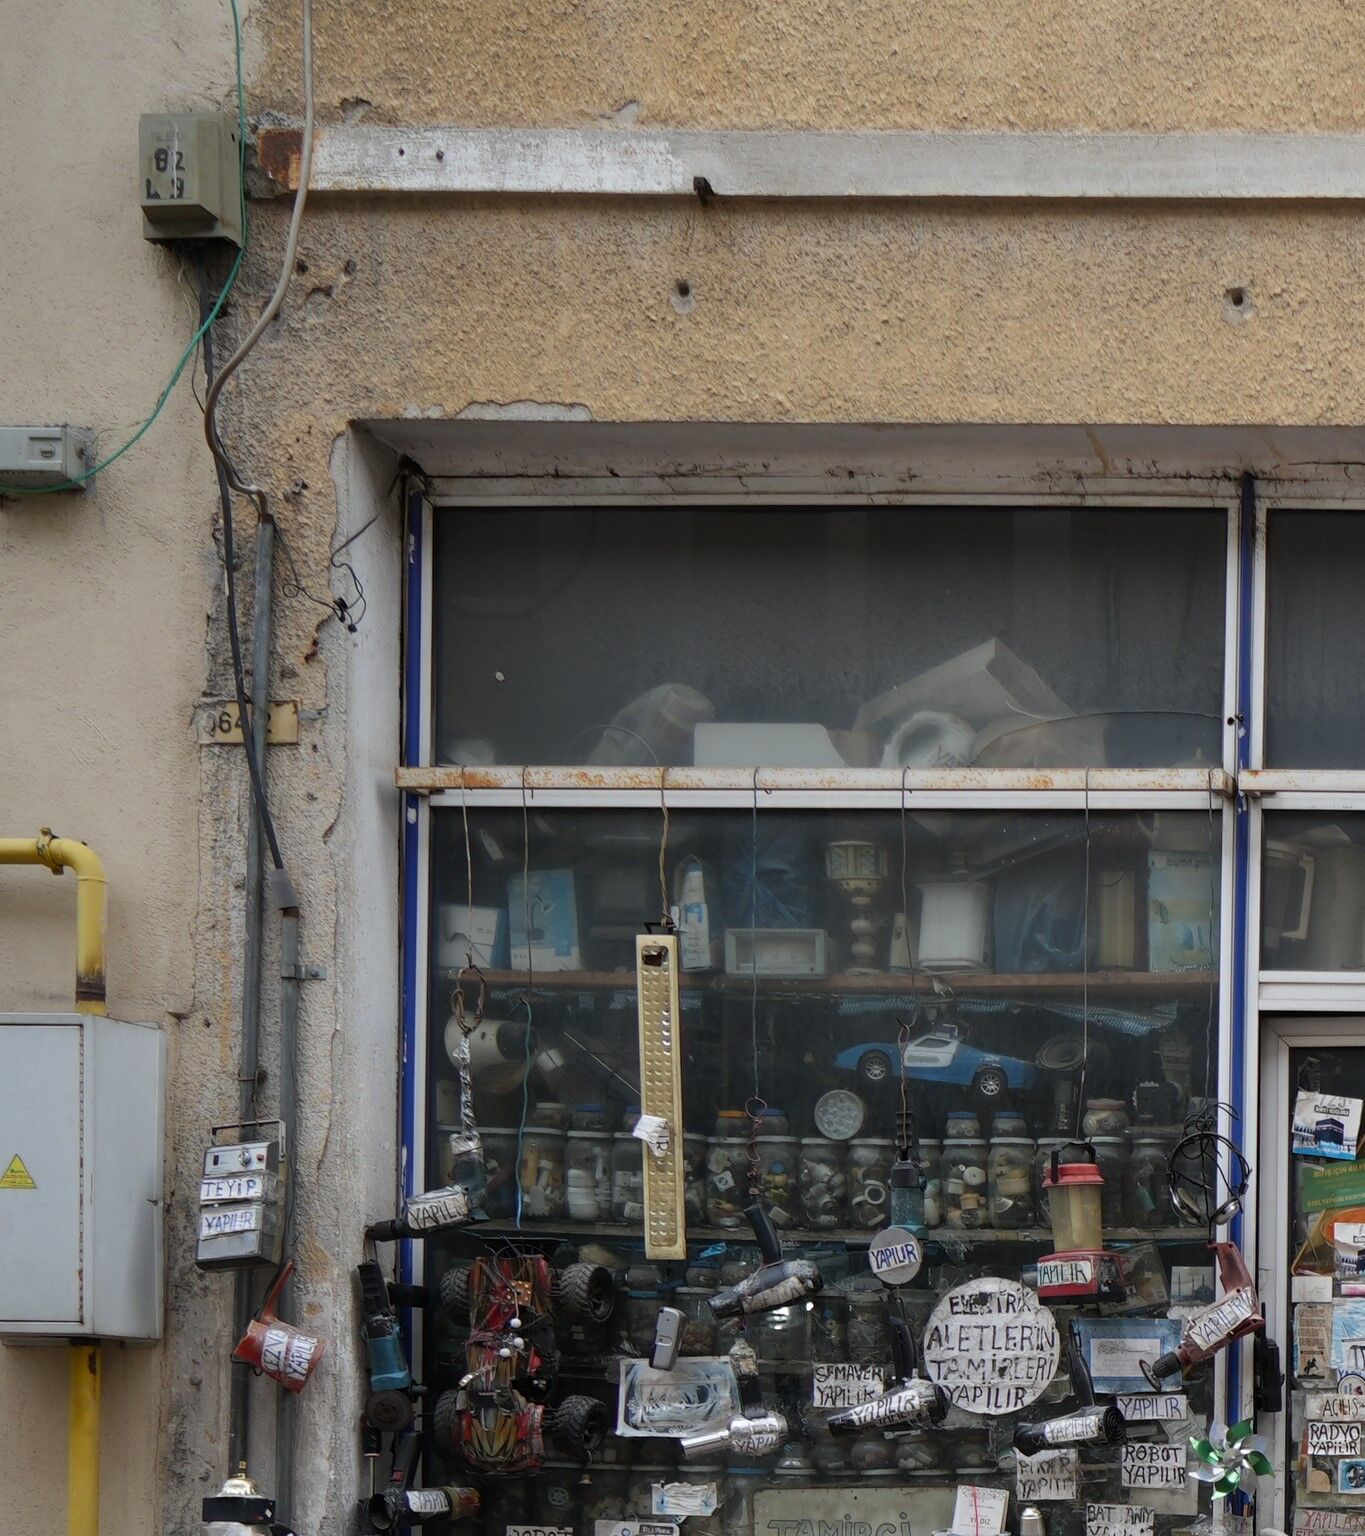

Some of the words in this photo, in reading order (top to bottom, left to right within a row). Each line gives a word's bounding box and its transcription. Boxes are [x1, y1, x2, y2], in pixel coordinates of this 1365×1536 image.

[202, 1178, 256, 1197] TEYİP
[872, 1243, 917, 1269] YAPILIR
[1122, 1398, 1182, 1419] YAPILIR
[1310, 1423, 1360, 1440] RADYO
[1124, 1444, 1180, 1463] ROBOT
[1124, 1464, 1185, 1486] YAPILIR
